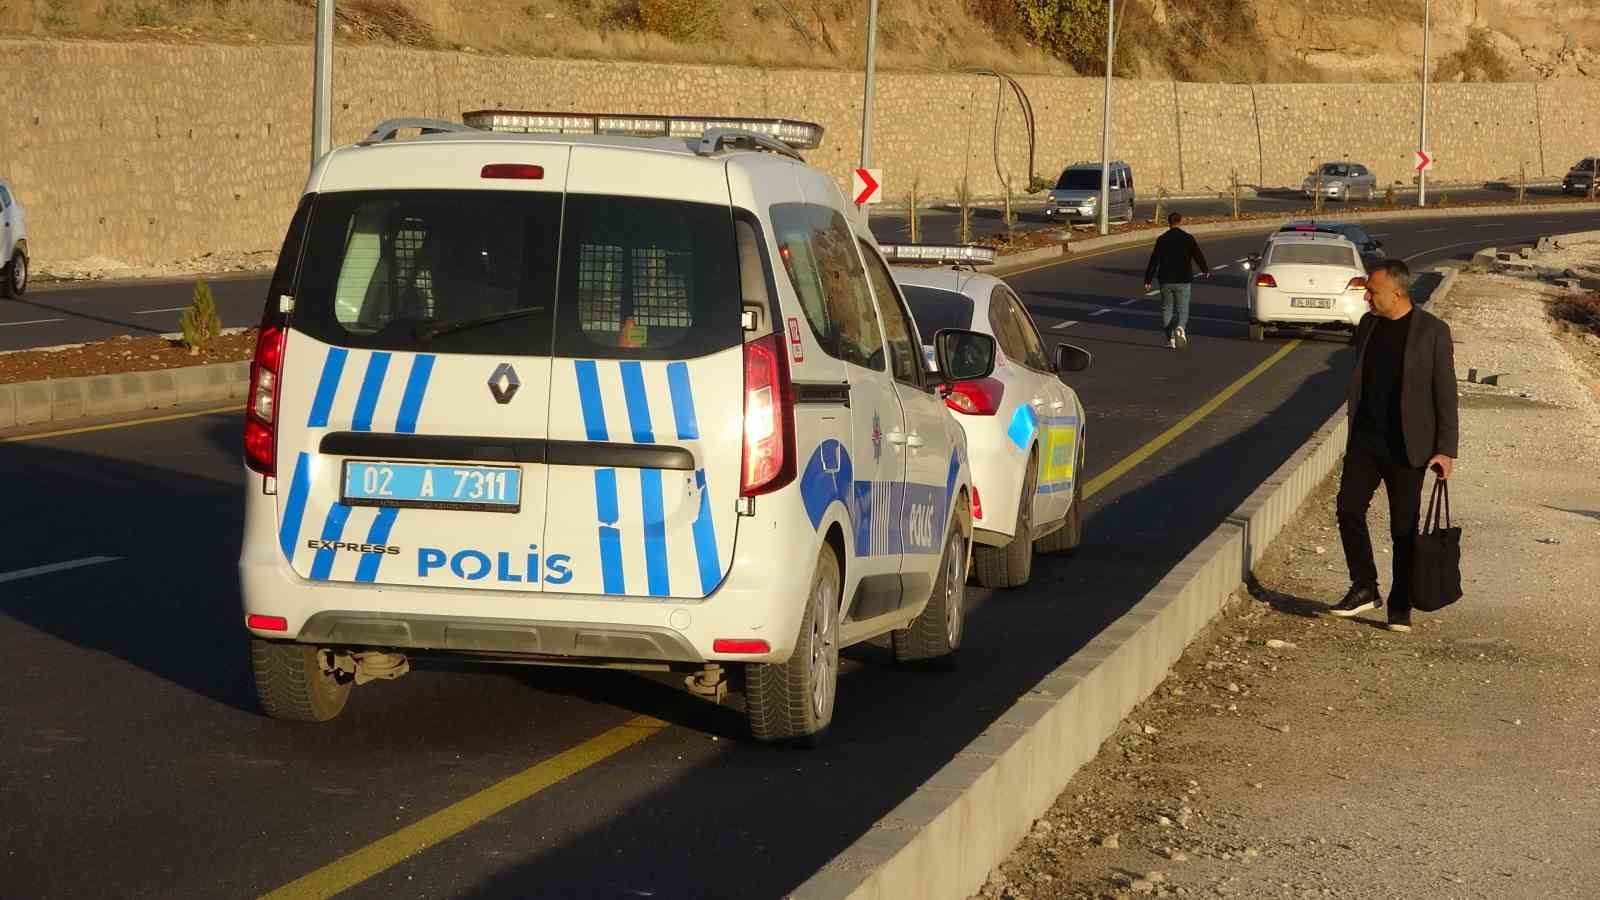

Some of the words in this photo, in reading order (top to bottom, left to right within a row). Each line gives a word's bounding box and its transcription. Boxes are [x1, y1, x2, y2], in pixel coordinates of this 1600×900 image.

[363, 466, 393, 496] 02
[420, 469, 435, 497] A
[453, 470, 506, 500] 7311
[307, 539, 401, 556] EXPRESS
[417, 543, 574, 585] POLİS
